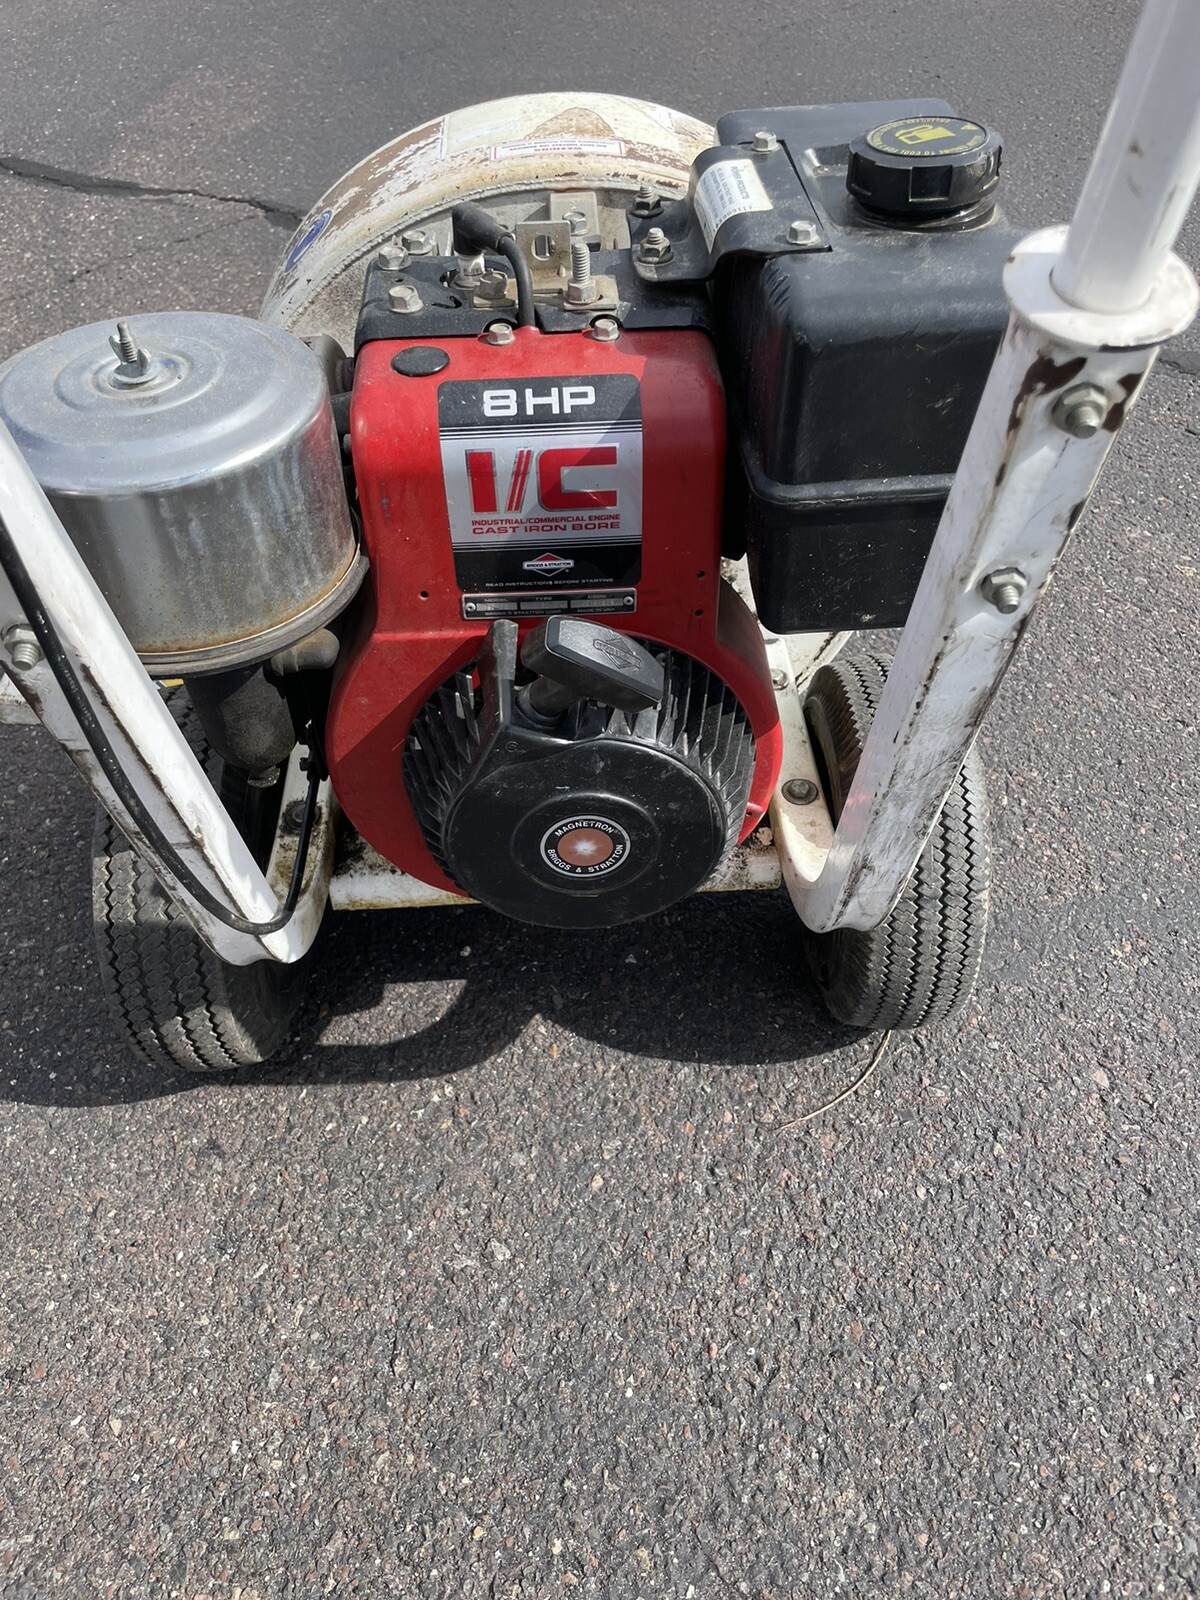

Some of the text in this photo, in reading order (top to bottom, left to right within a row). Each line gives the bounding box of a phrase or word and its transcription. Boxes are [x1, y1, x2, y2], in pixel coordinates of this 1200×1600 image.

[471, 514, 621, 526] INDUSTRIAL/COMMERCIAL ENGINE
[472, 521, 621, 535] CAST IRON BORE
[554, 820, 615, 837] MAGNETRON
[547, 848, 572, 871] BRIGGS
[587, 844, 624, 873] STRATTON
